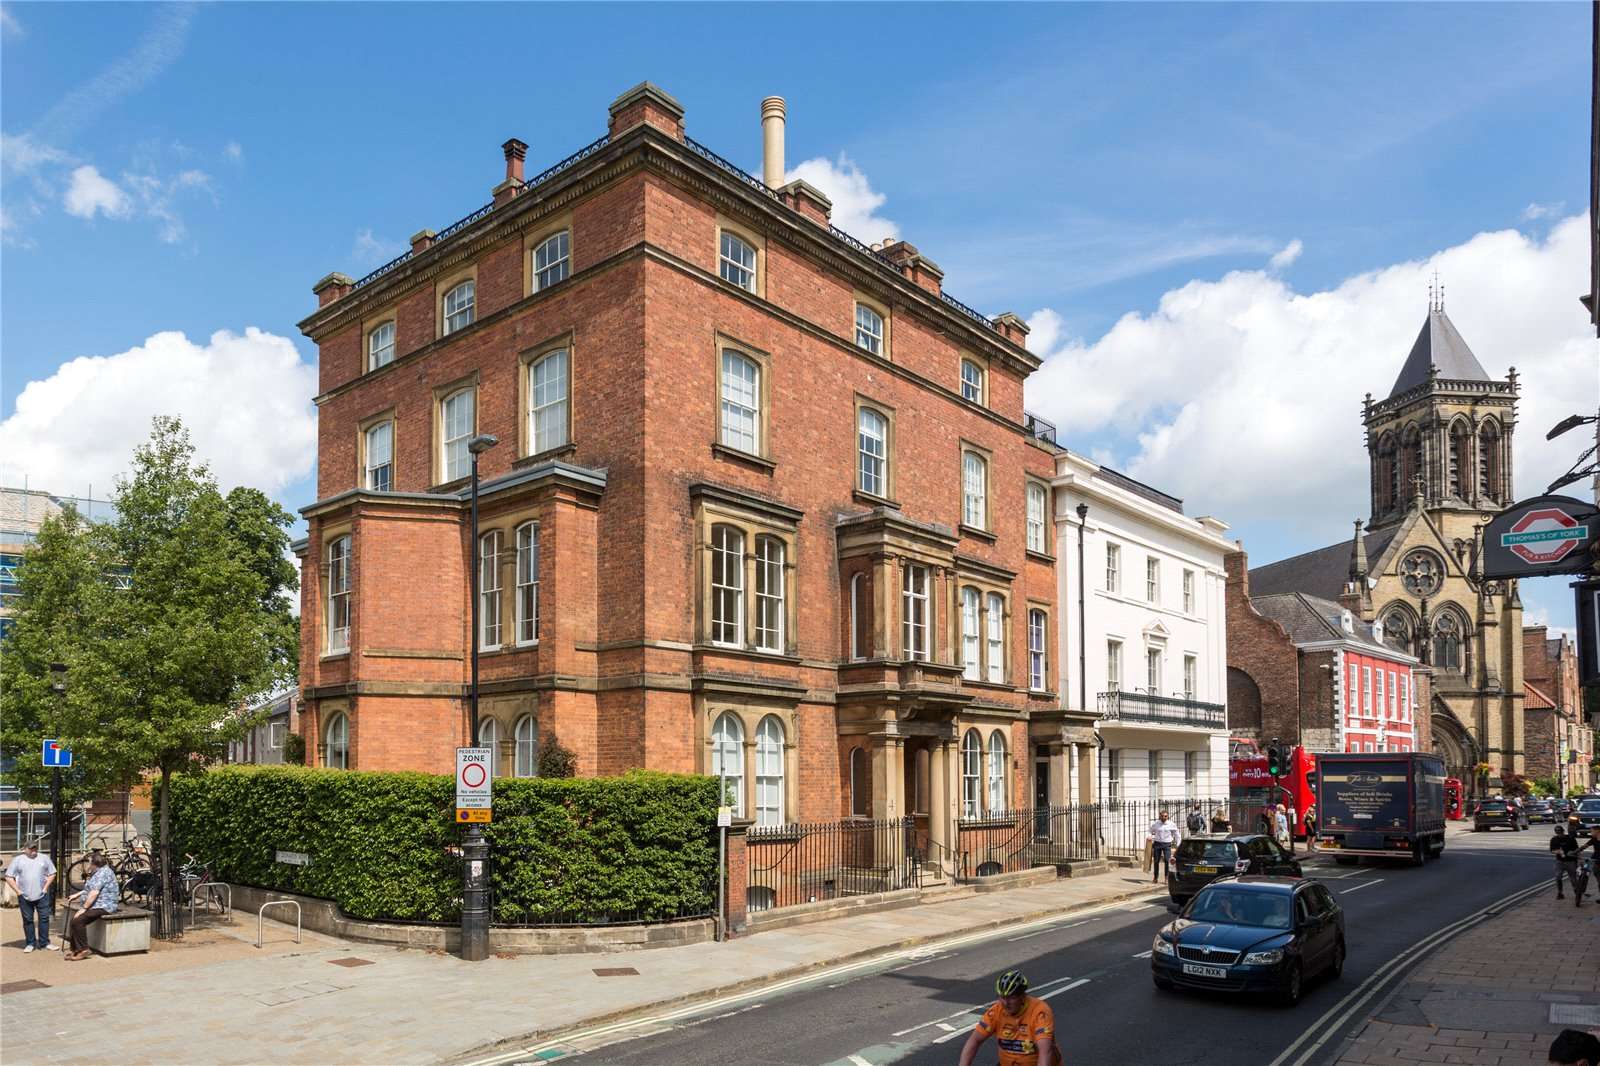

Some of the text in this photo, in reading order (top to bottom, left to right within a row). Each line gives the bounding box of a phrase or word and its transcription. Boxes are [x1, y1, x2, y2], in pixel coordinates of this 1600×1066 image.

[1547, 531, 1559, 539] OF
[1560, 529, 1581, 538] YORK
[1253, 767, 1261, 779] 10
[1205, 967, 1222, 977] NXK
